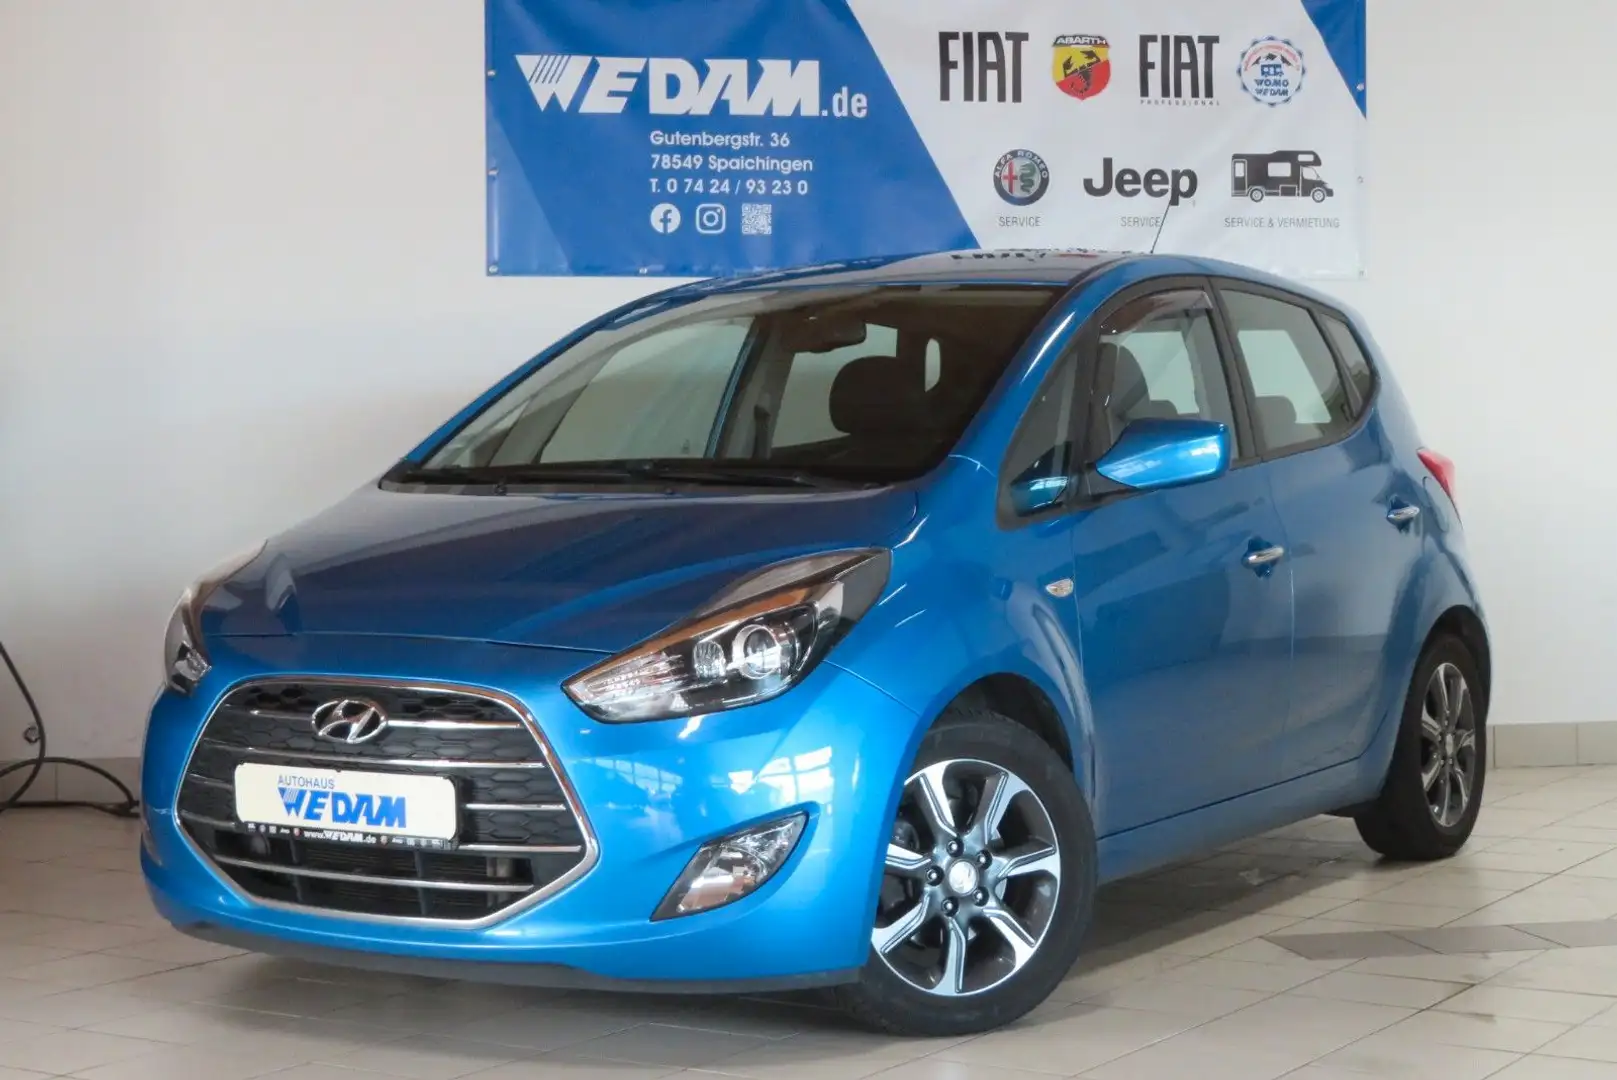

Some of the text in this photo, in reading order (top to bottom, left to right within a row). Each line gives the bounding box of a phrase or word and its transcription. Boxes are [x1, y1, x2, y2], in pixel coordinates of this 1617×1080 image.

[1056, 35, 1106, 46] ABARTH
[939, 31, 1029, 103] FIAT
[1139, 34, 1220, 98] FIAT
[514, 54, 868, 118] WEDAM.de
[650, 130, 790, 150] Gutenbergstr. 36
[651, 154, 813, 174] 78549 Spaichingen
[994, 151, 1048, 179] ALFA ROMEO
[649, 178, 808, 196] T. 0 74 24 / 93 23 0
[1083, 157, 1198, 206] Jeep
[999, 216, 1041, 227] SERVICE
[1120, 216, 1161, 227] SERVICE
[1224, 217, 1340, 229] SERVICE & VERMIETUNG
[278, 775, 335, 790] AUTOHAUS
[277, 787, 406, 828] WEDAM
[304, 829, 377, 844] www.WEDAM.de
